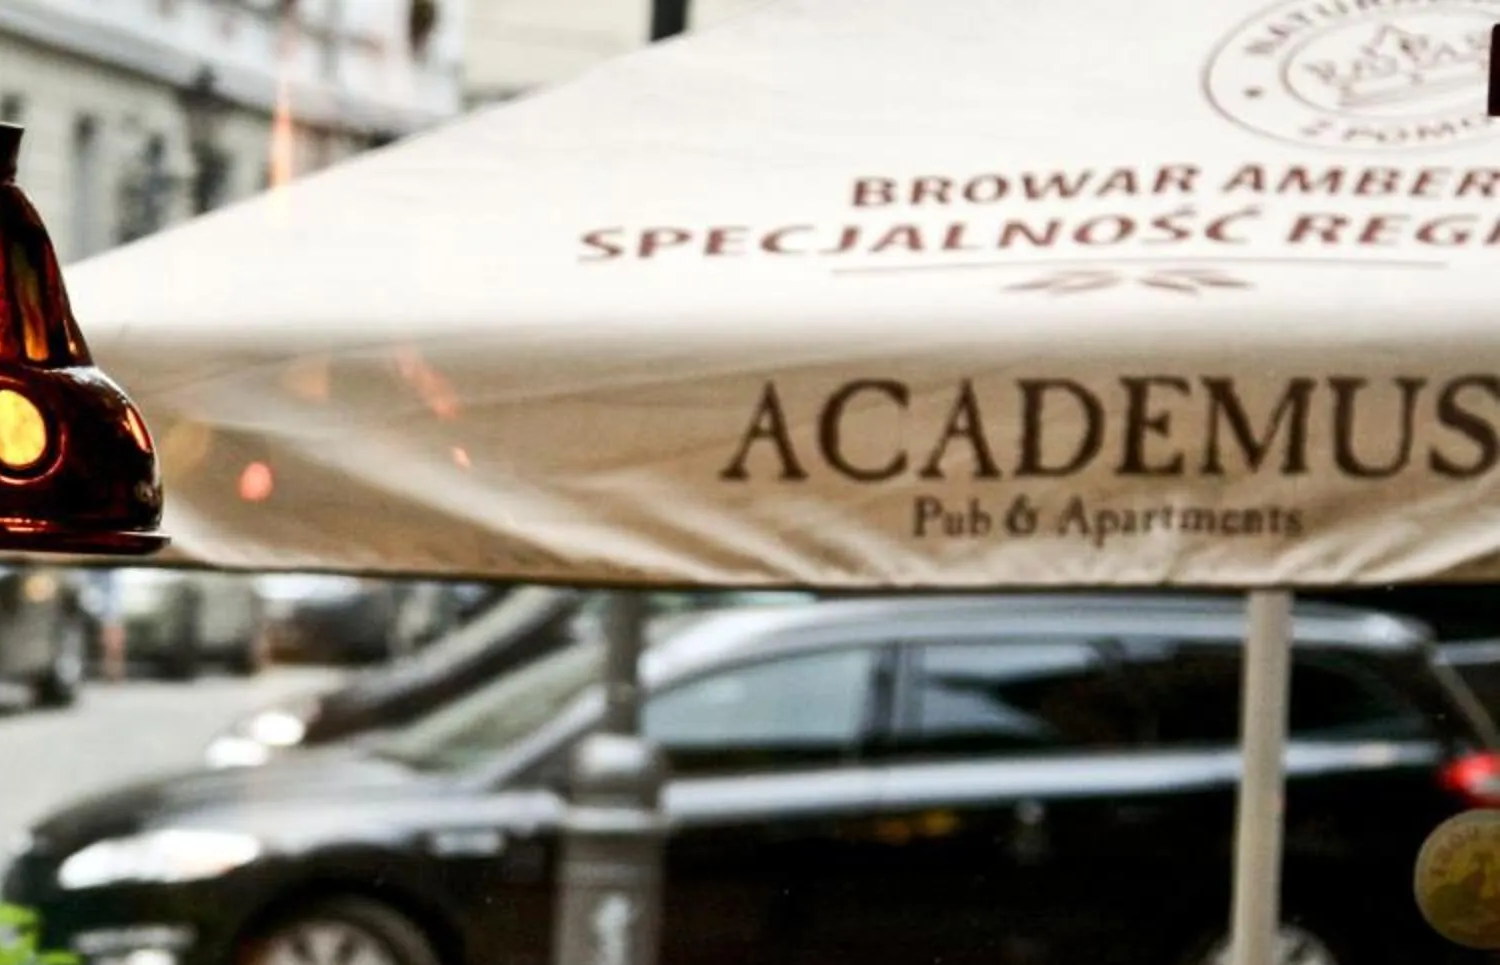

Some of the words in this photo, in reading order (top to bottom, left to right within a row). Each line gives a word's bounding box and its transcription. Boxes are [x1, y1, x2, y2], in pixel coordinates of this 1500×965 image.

[850, 164, 1201, 208] BROWAR
[1221, 163, 1500, 199] AMBER
[576, 204, 1262, 264] SPECJALNOŚĆ
[717, 375, 1500, 483] ACADEMUS
[913, 496, 992, 538] Pub
[1005, 494, 1038, 537] &
[1056, 496, 1304, 548] Apartments
